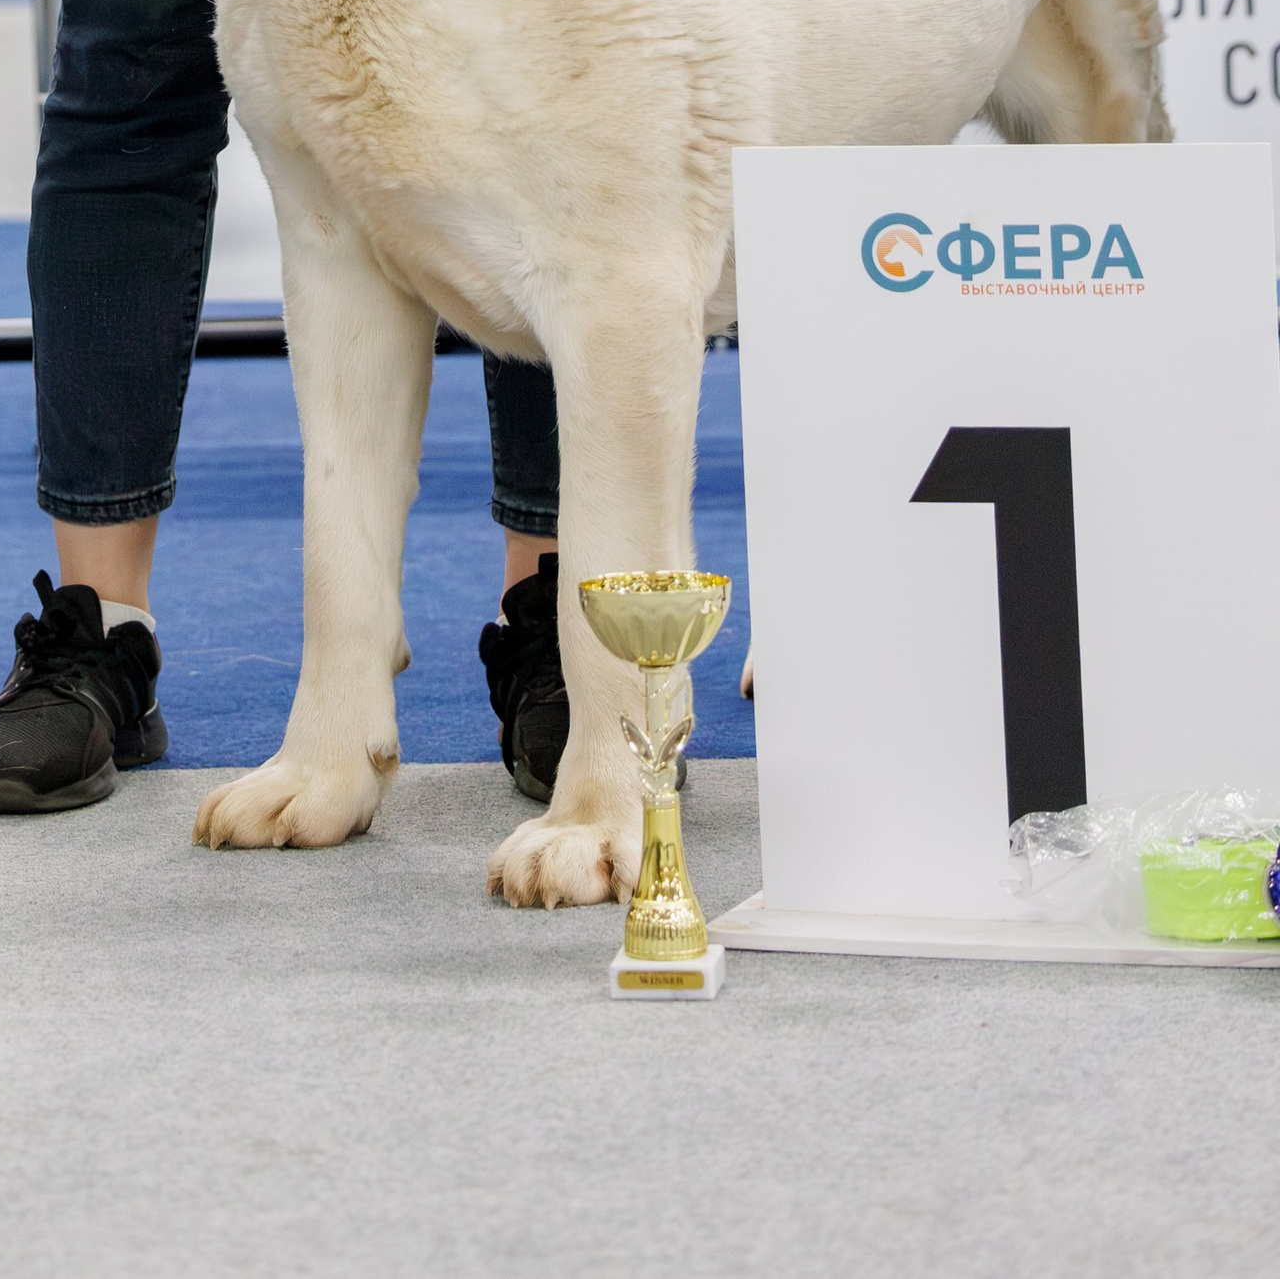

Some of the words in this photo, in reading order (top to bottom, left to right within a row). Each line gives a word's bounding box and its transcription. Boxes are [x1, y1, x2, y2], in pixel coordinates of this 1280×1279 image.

[1225, 42, 1280, 105] С
[861, 212, 1145, 293] СФЕРА
[960, 281, 1087, 296] ВЫСТАВОЧНЫЙ
[1092, 282, 1146, 298] ЦЕНТР
[908, 426, 1090, 849] 1
